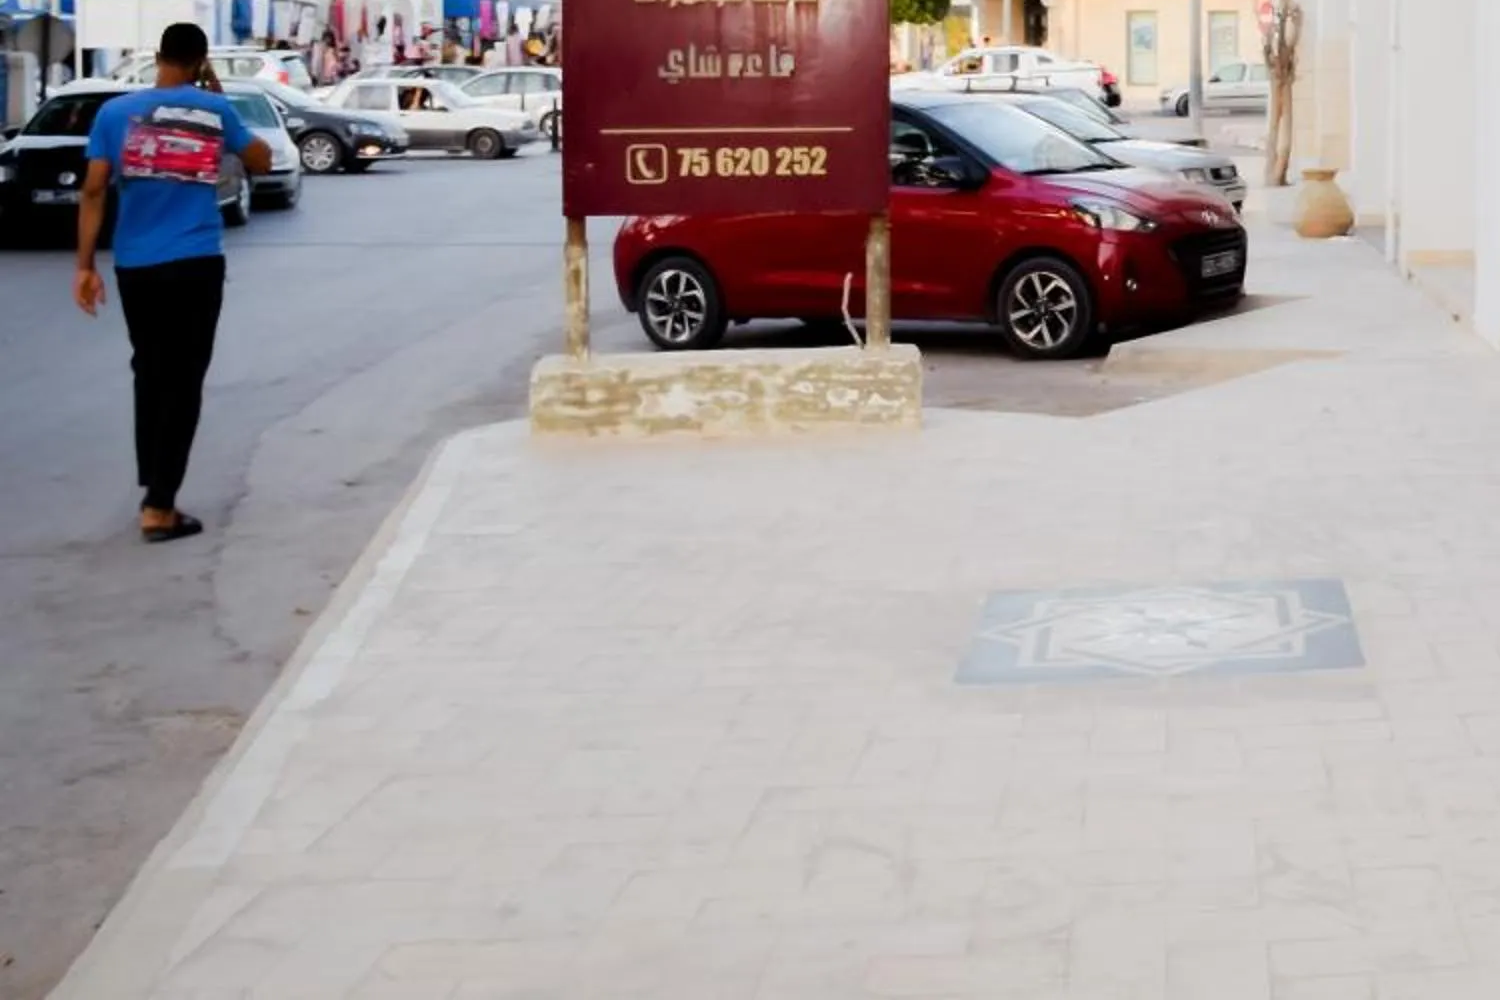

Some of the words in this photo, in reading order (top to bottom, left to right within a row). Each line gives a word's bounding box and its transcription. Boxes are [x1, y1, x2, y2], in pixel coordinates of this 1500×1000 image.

[657, 43, 722, 85] شاي
[677, 146, 711, 178] 75
[716, 146, 771, 178] 620
[774, 145, 828, 177] 252
